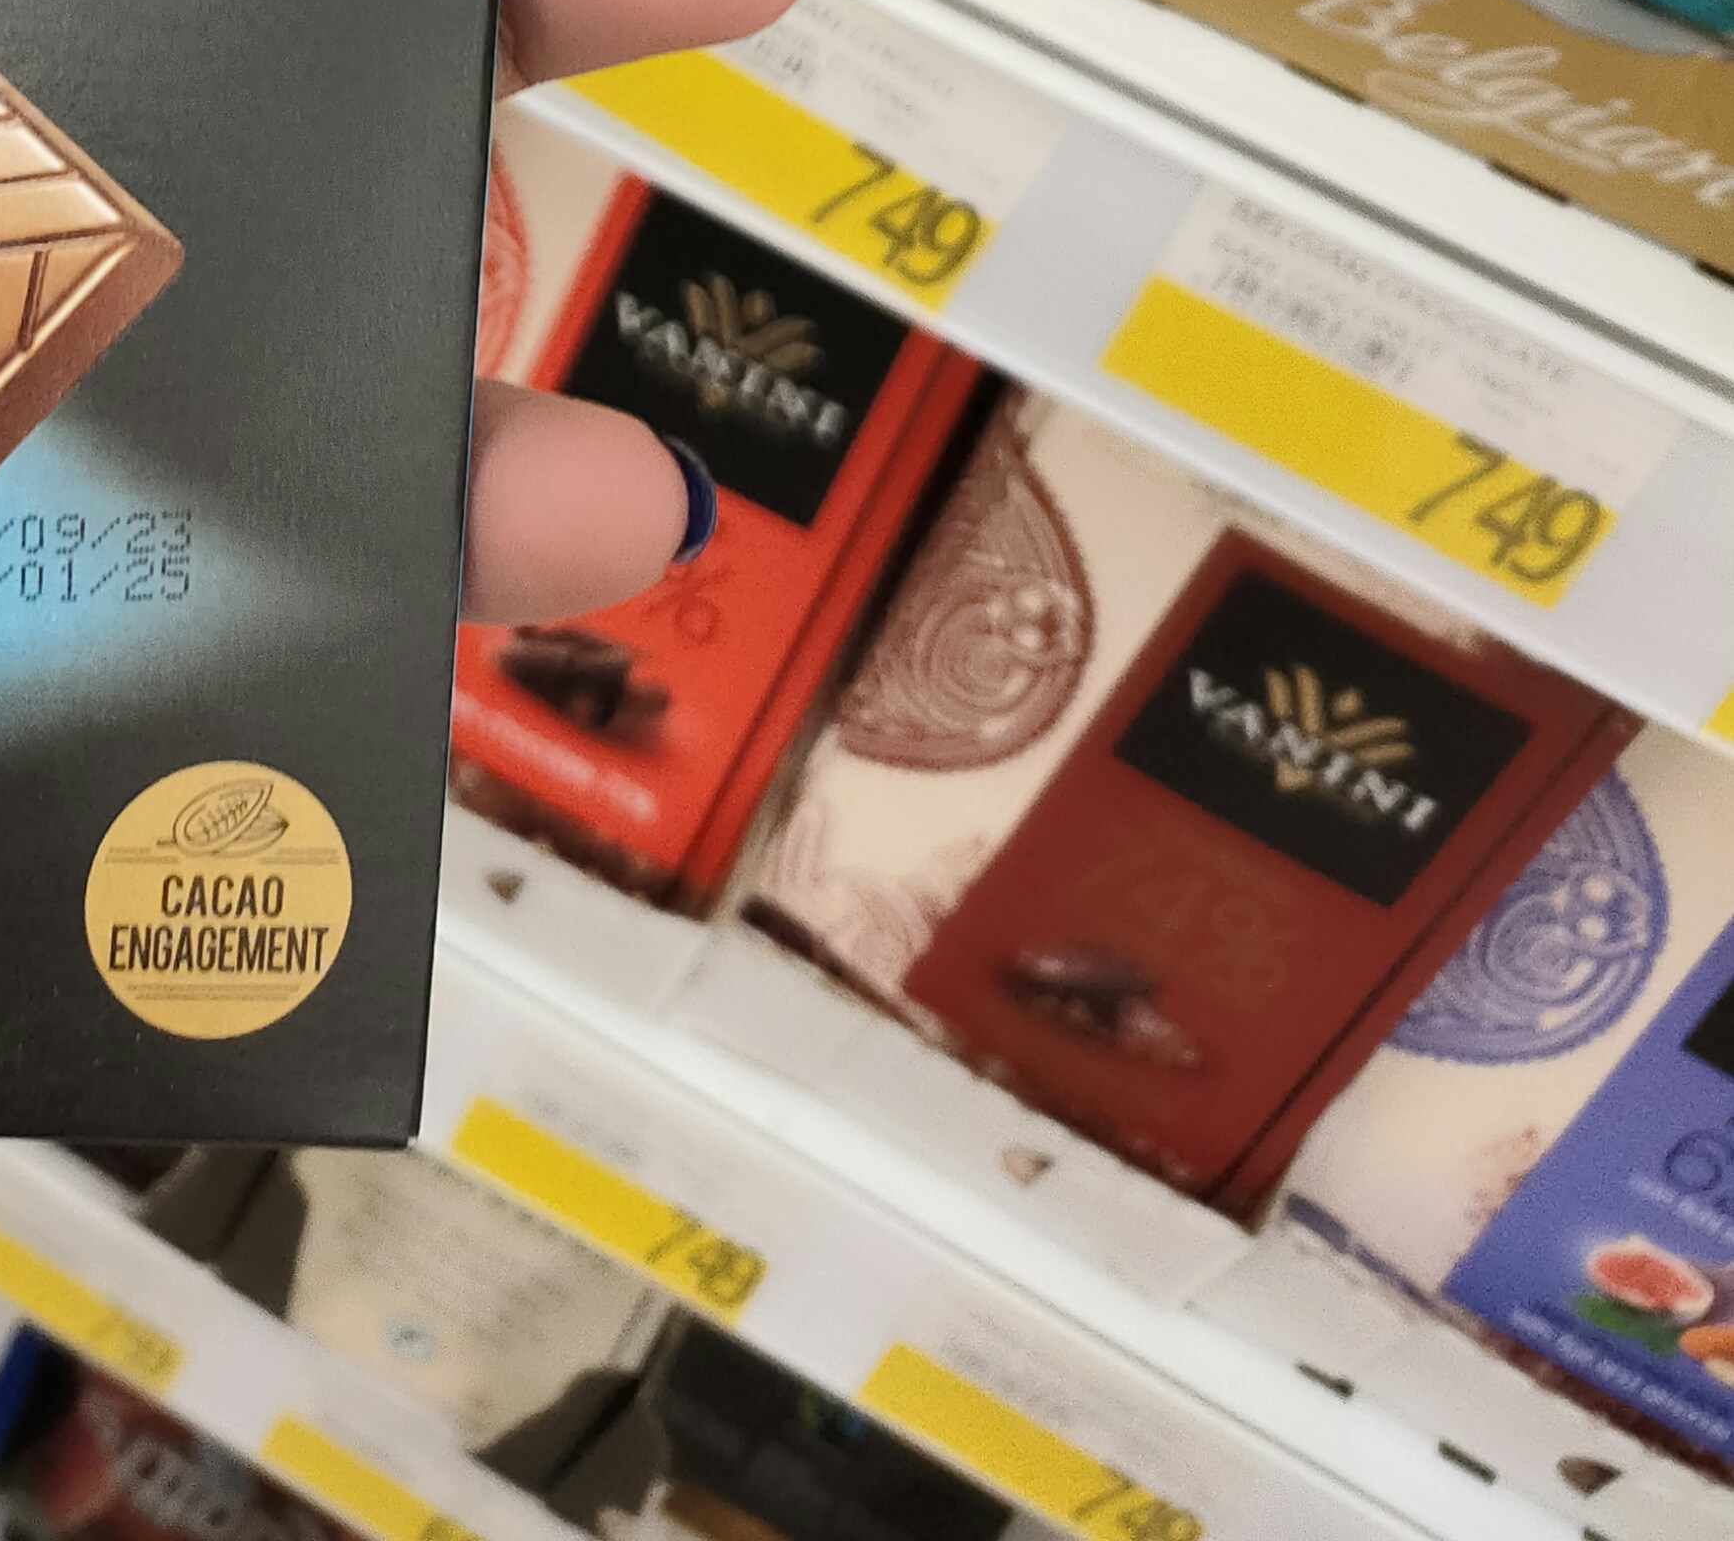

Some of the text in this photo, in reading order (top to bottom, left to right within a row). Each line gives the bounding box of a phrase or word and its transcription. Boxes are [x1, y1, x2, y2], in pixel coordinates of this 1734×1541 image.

[810, 140, 983, 285] 749
[616, 290, 847, 443] VANINI
[1407, 432, 1605, 584] 749
[1189, 666, 1438, 831] VANINI
[108, 923, 330, 973] ENGAGEMENT
[161, 874, 285, 919] CACAO
